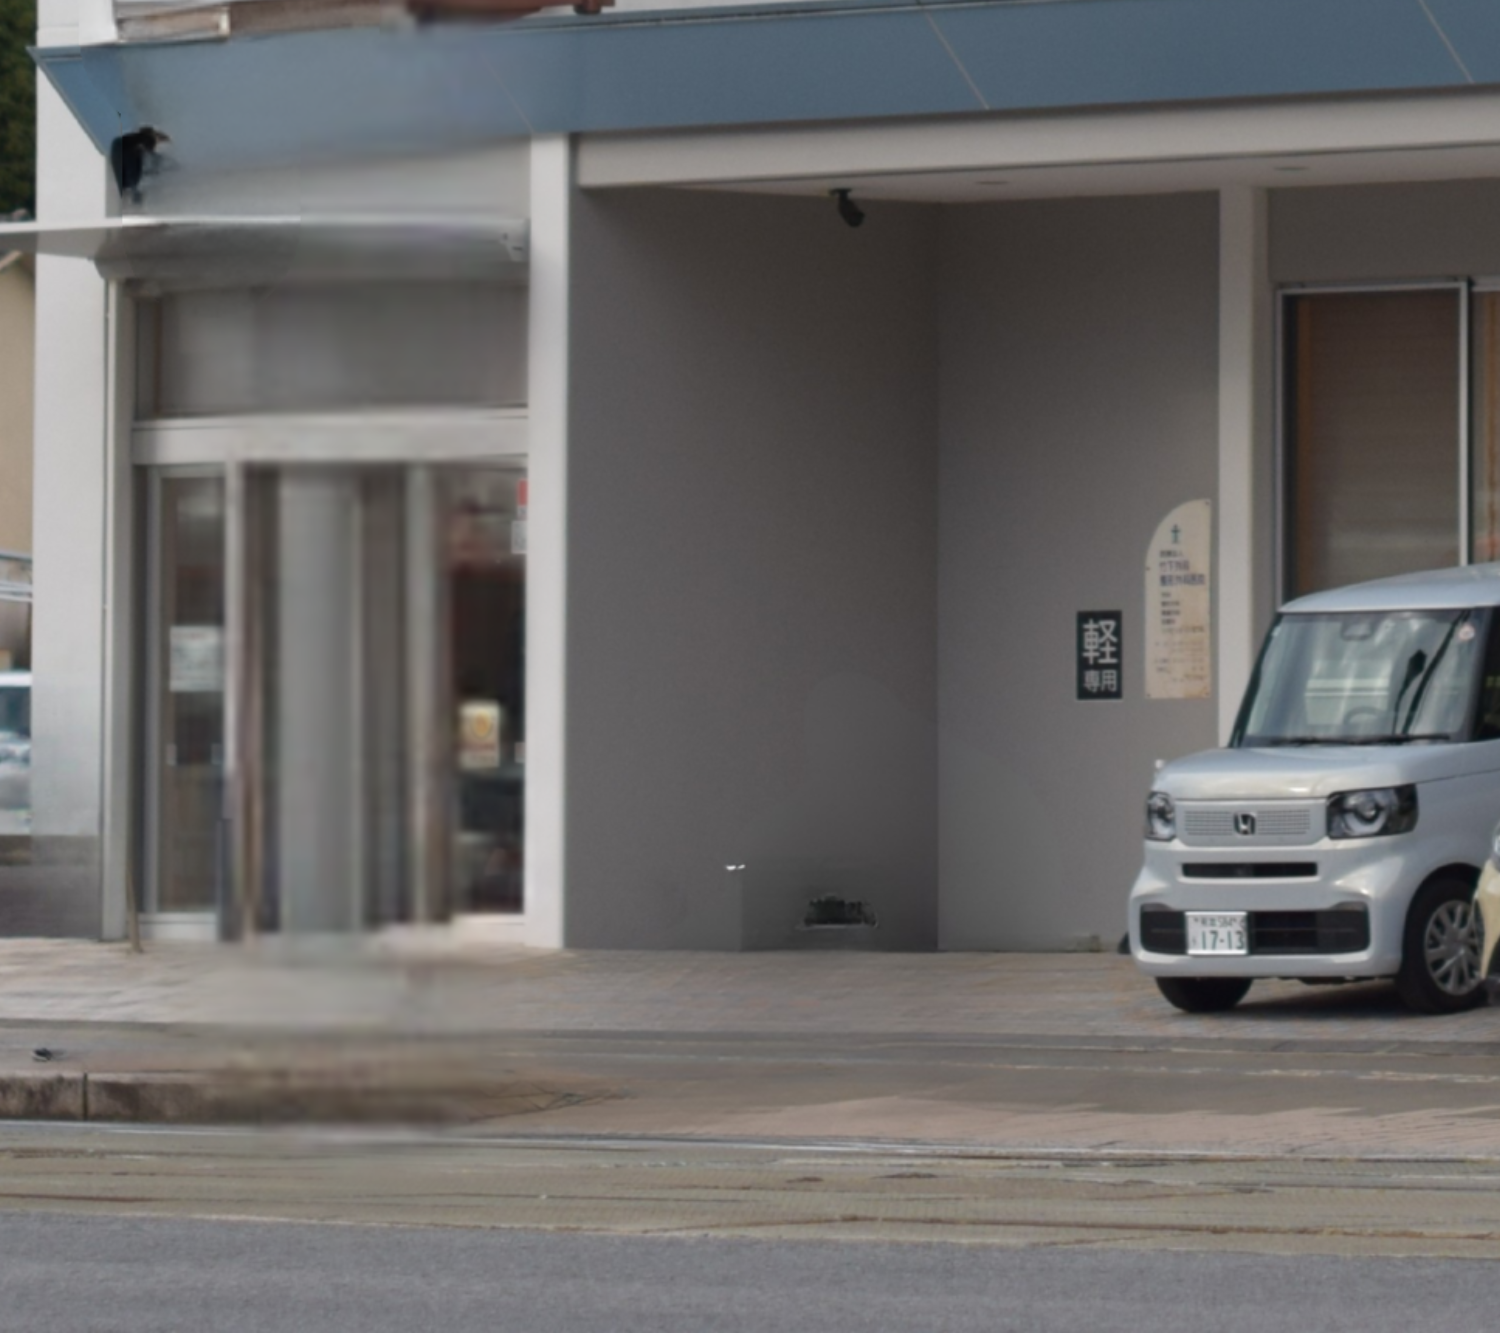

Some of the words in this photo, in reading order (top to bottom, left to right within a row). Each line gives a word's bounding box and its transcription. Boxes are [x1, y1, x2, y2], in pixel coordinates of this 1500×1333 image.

[1082, 618, 1118, 665] 軽
[1083, 669, 1118, 693] 専用
[1201, 929, 1245, 951] 17-13
